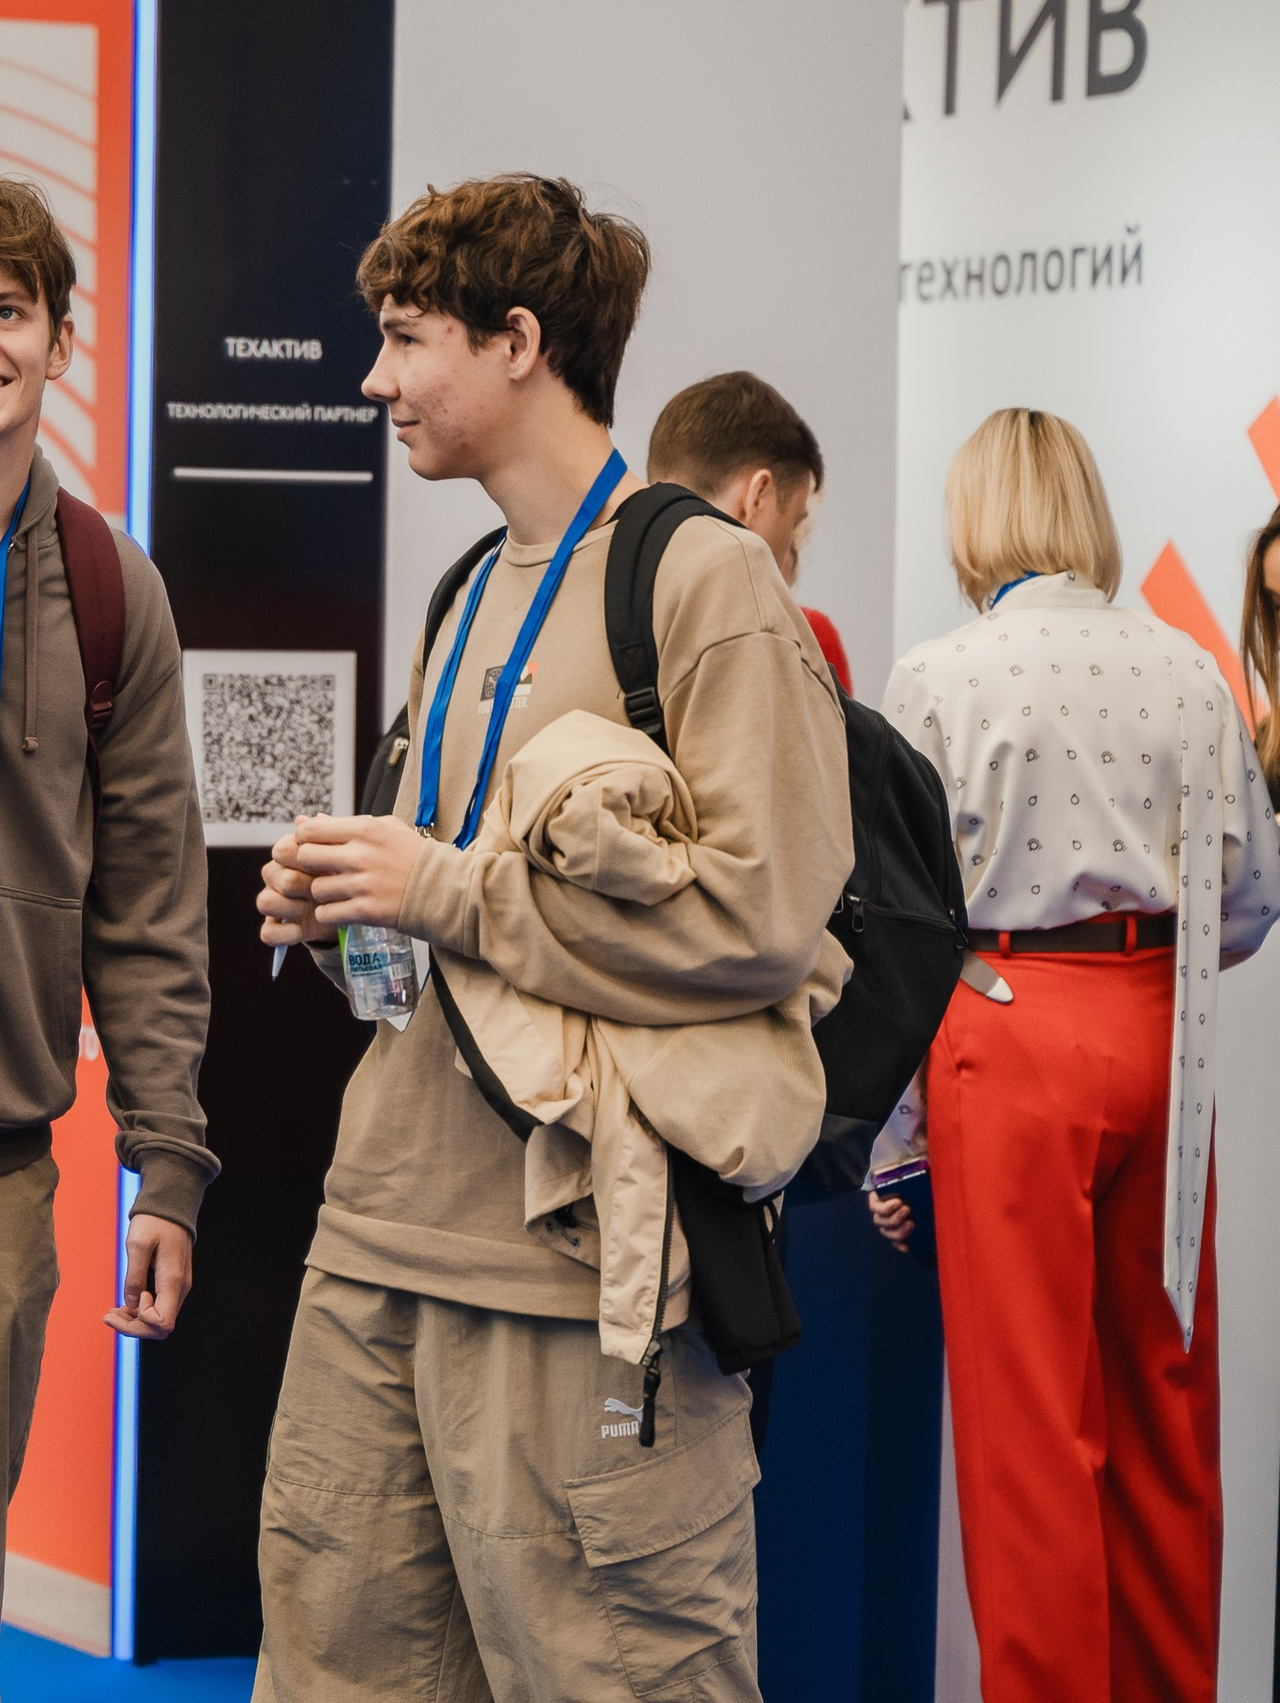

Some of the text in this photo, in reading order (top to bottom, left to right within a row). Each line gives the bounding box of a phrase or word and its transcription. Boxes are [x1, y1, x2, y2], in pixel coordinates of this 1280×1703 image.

[902, 0, 1148, 121] ТИВ
[225, 336, 323, 362] ТЕХАКТИВ
[167, 402, 379, 424] ТЕХНОЛОГИЧЕСКИЙ ПАРТНЕР
[349, 953, 380, 966] ВОДА
[601, 1420, 640, 1439] PUMA
